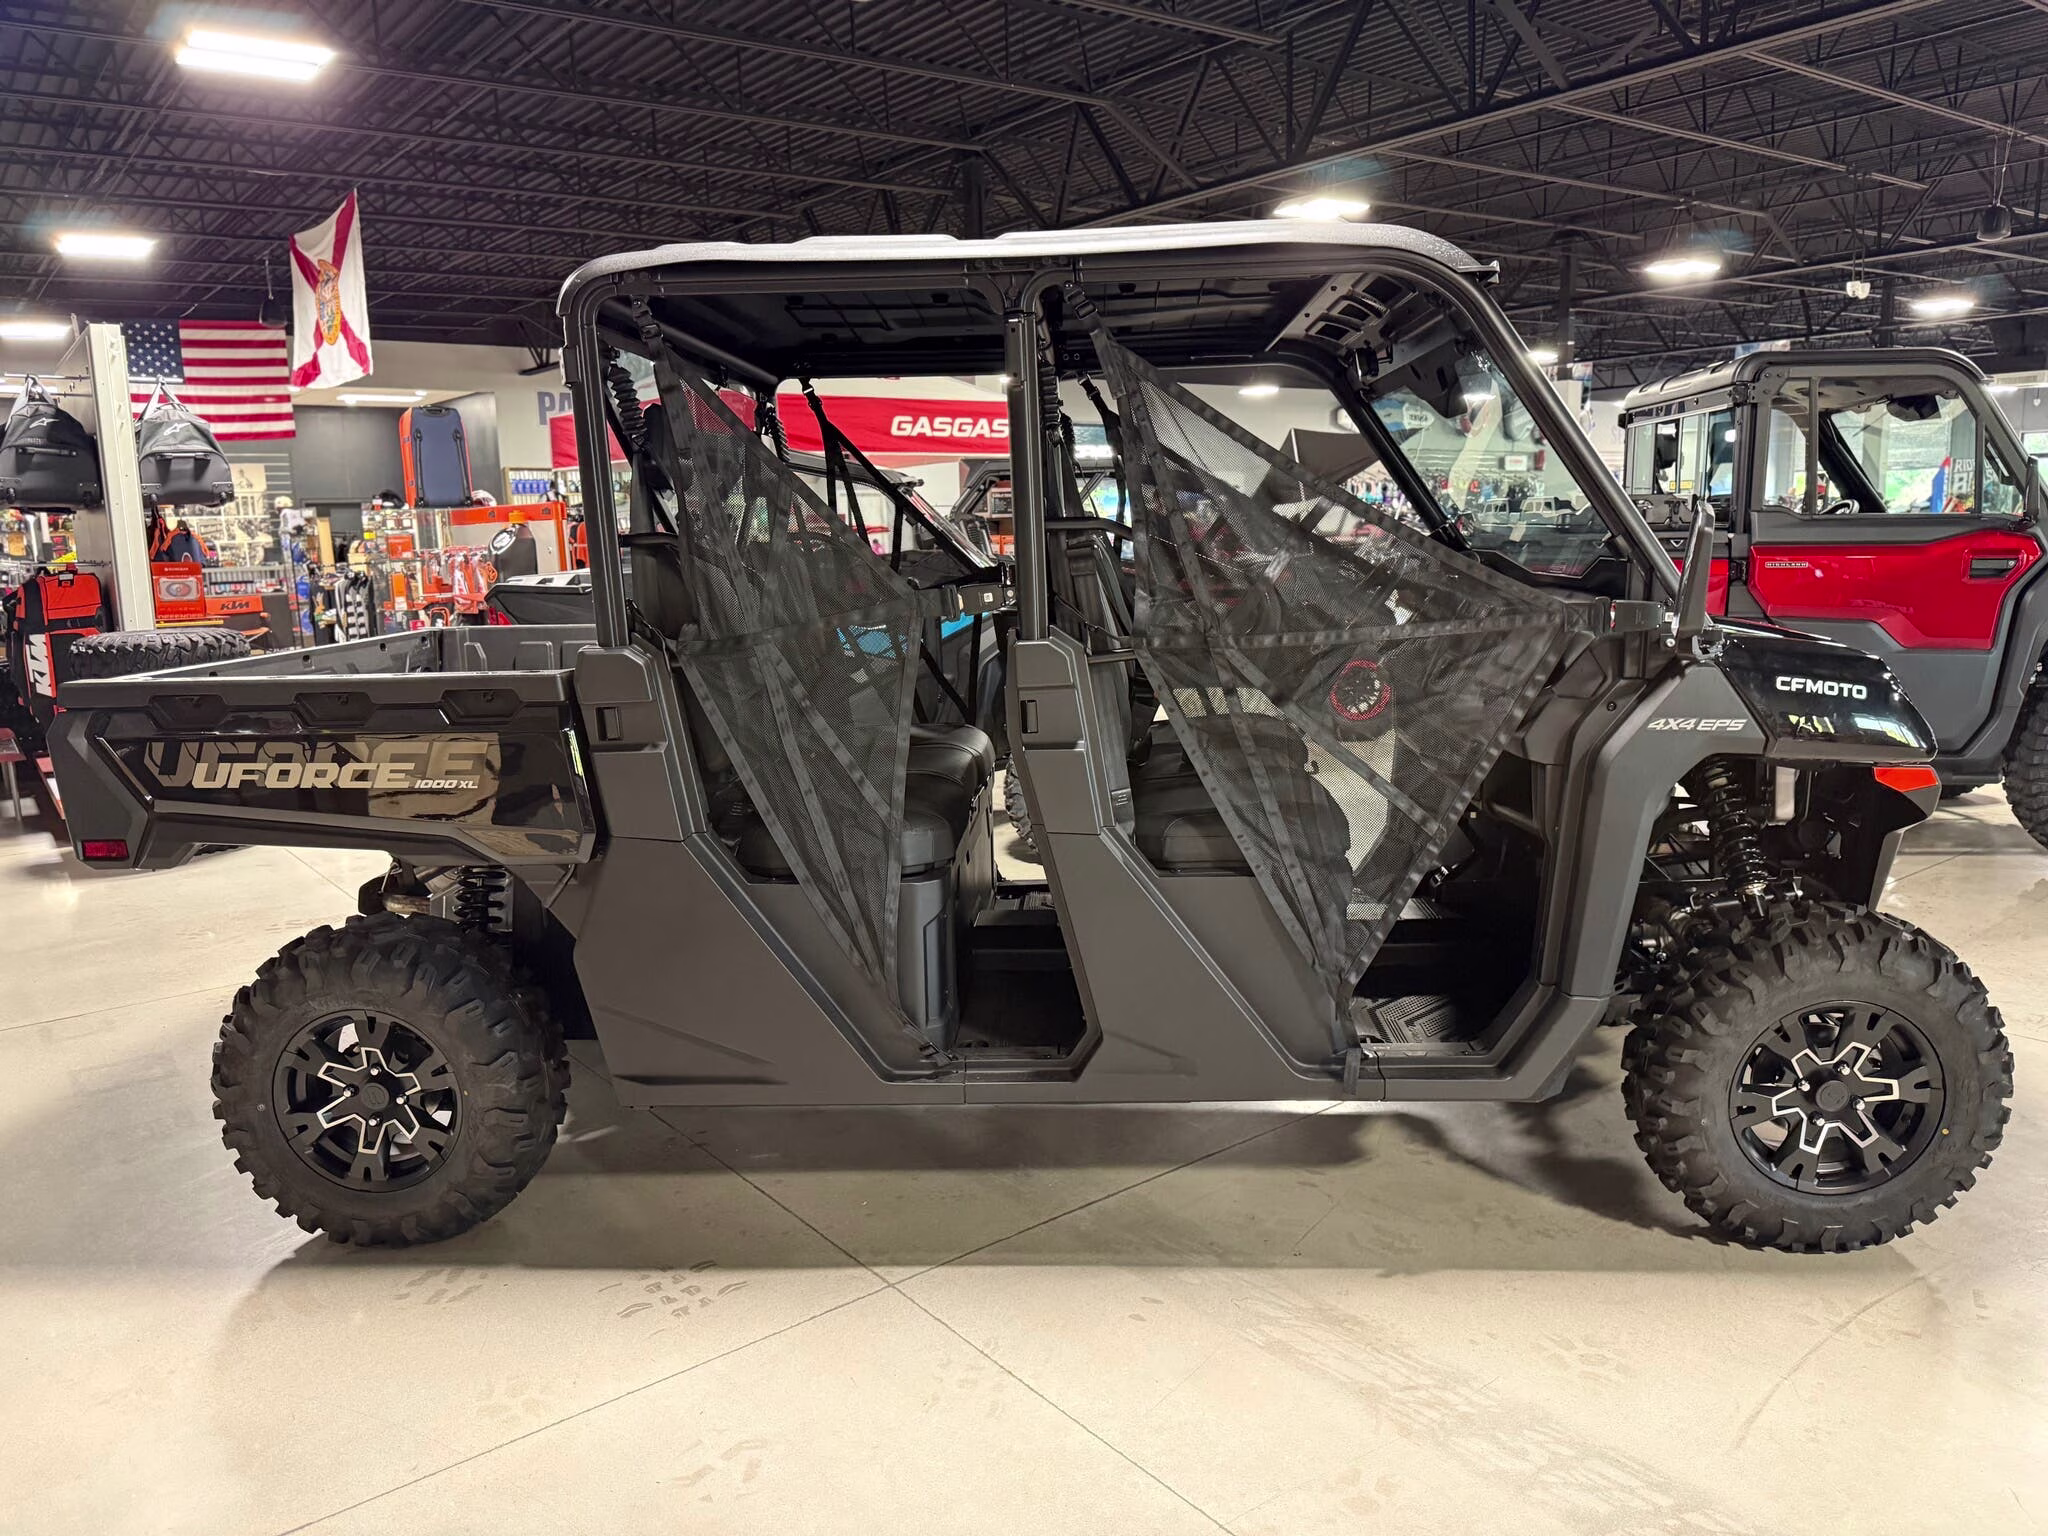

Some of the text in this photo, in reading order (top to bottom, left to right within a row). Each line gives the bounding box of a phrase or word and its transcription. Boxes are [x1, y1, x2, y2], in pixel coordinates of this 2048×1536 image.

[890, 415, 1009, 438] GASGAS
[221, 601, 250, 611] KTM
[25, 633, 53, 697] KTM
[1776, 676, 1867, 700] CFMOTO
[192, 763, 415, 788] UFORCE
